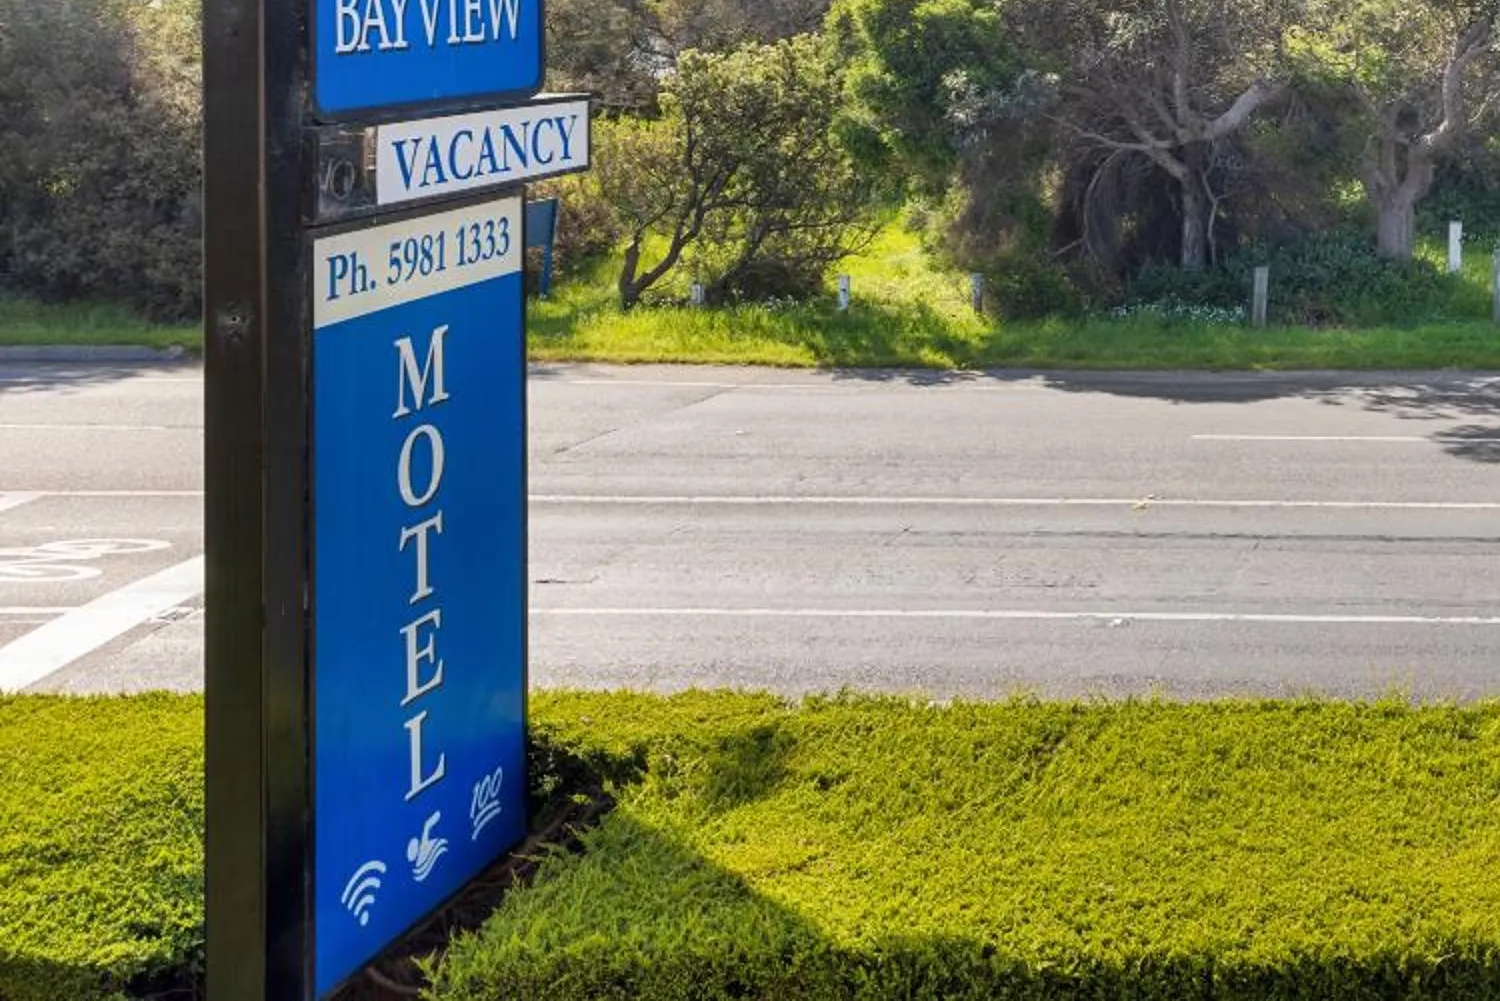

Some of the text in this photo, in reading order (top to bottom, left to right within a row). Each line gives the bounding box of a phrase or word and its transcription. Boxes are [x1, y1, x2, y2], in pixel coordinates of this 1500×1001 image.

[391, 115, 577, 192] VACANCY
[326, 216, 510, 300] Ph. 5981 1333
[392, 324, 451, 801] MOTEL
